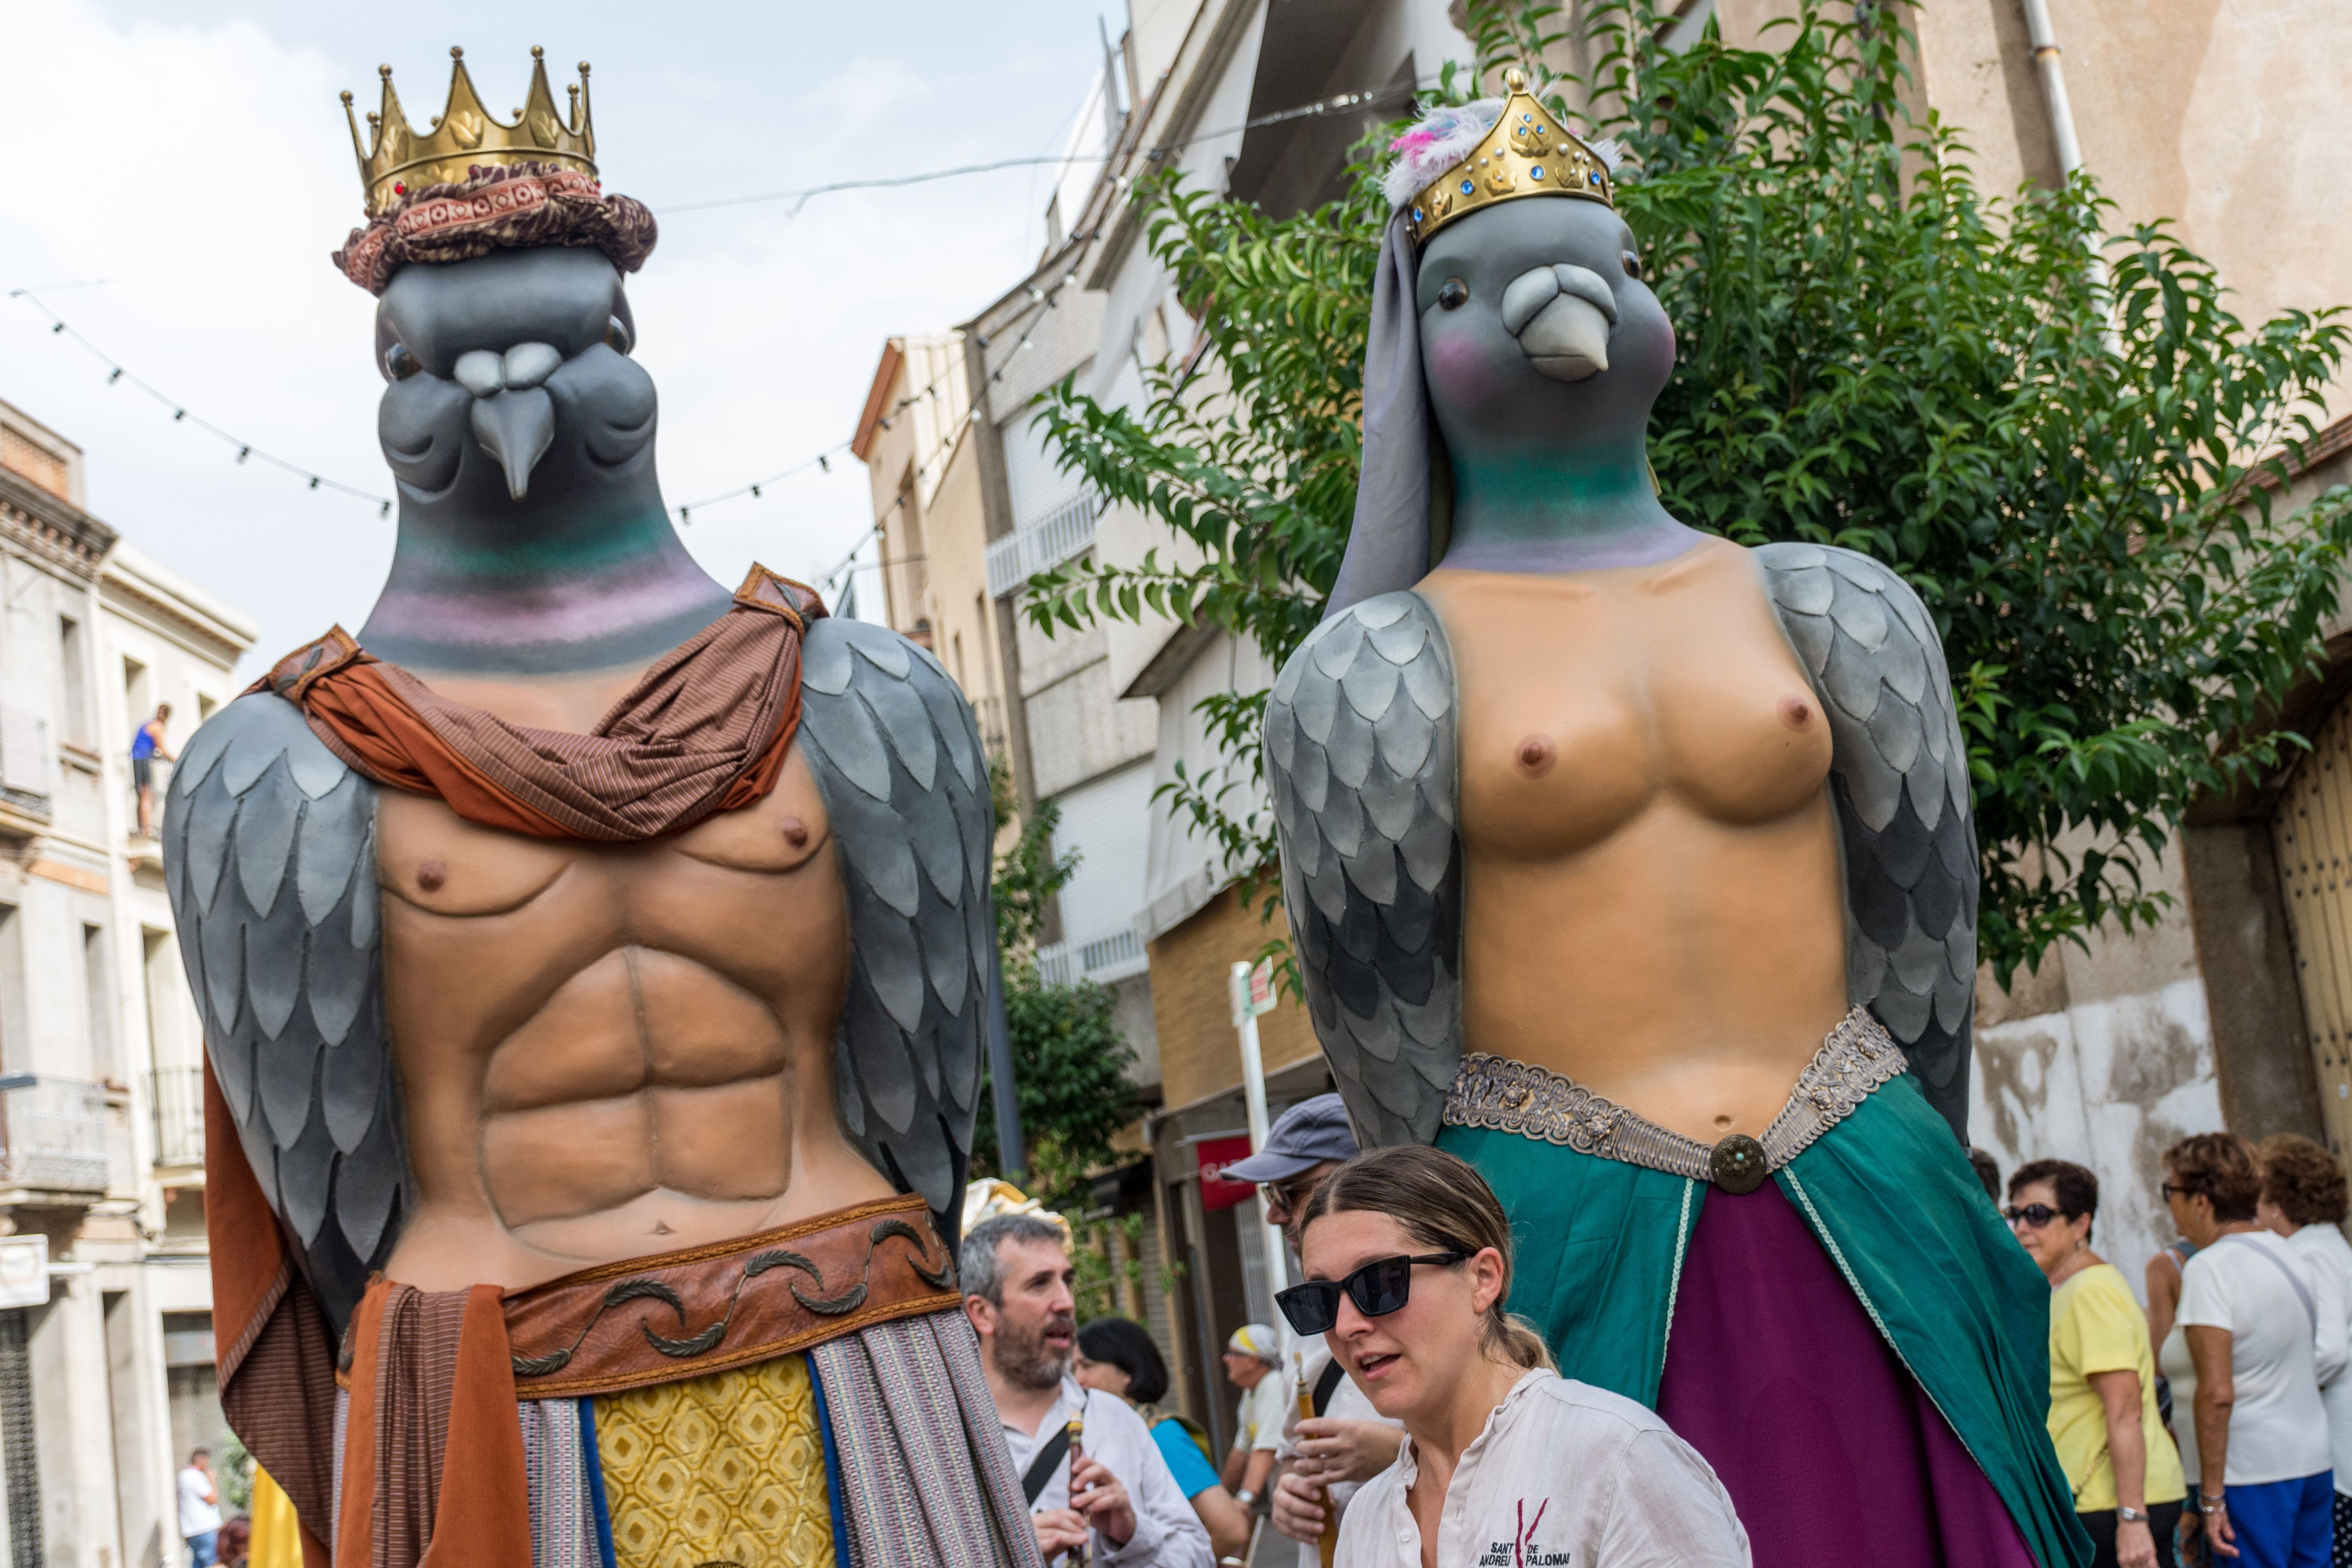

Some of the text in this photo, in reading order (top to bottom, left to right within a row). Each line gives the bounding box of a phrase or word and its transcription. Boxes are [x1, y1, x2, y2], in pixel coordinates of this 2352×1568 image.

[1491, 1542, 1514, 1554] SANT
[1527, 1544, 1539, 1554] DE
[1479, 1554, 1511, 1567] ANDREU
